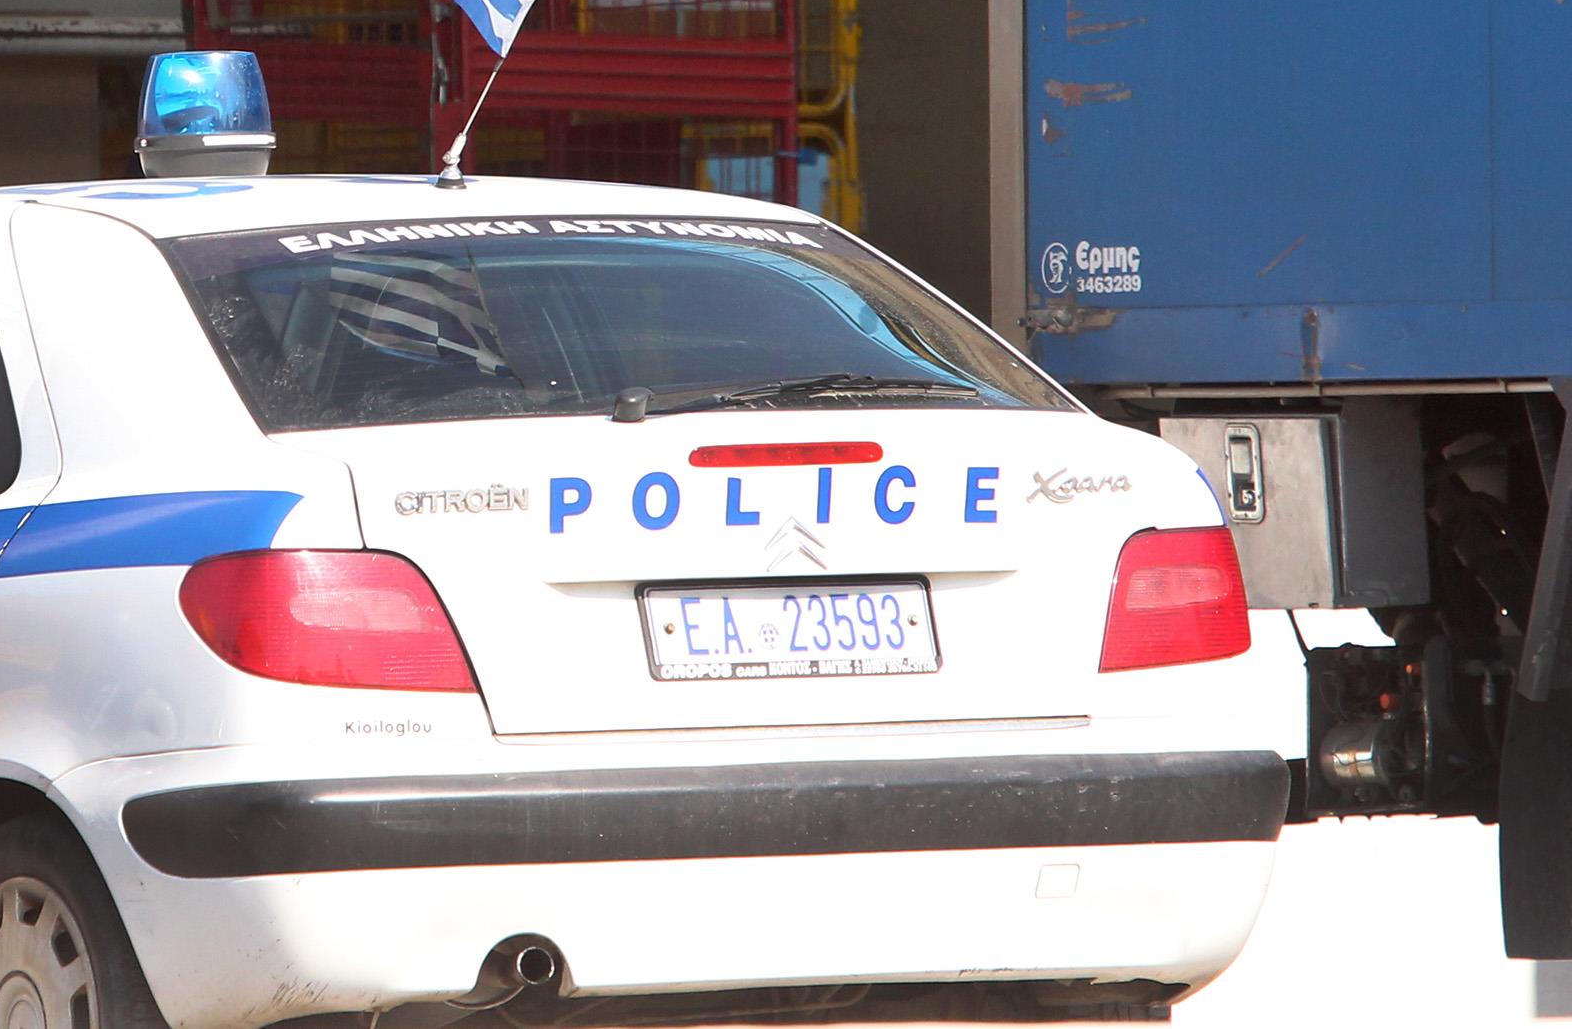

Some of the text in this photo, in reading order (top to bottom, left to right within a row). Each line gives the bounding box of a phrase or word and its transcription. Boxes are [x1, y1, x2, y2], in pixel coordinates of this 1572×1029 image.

[278, 219, 825, 254] ΕΛΛΗΝΙΚΗ ΑΣΤΥΝΟΜΙΑ
[1076, 274, 1142, 293] 3463289
[395, 483, 529, 516] CITROËN
[549, 466, 1000, 533] POLICE
[783, 593, 904, 652] 23593
